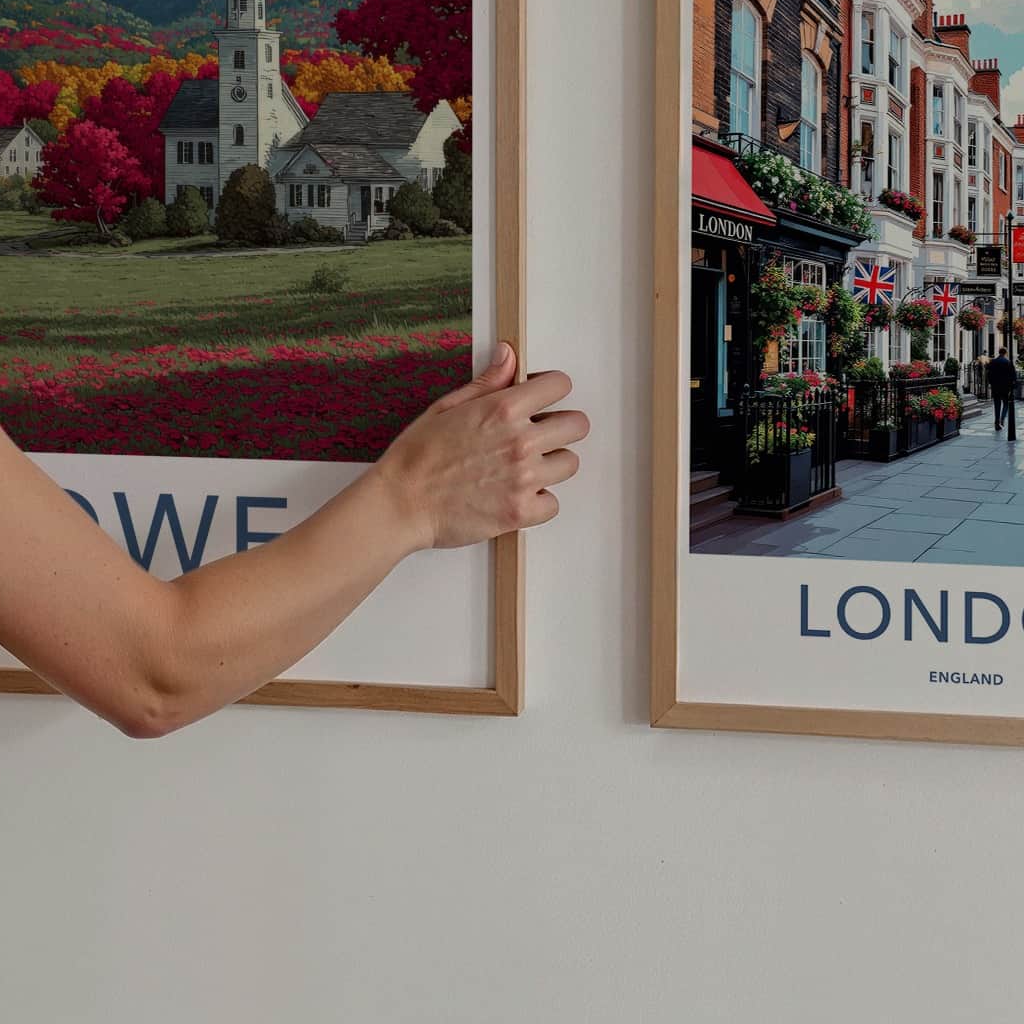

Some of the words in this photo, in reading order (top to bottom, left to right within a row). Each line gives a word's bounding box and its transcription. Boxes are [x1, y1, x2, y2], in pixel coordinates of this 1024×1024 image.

[699, 213, 753, 242] LONDON
[800, 584, 1024, 644] LOND
[929, 671, 1004, 686] ENGLAND
